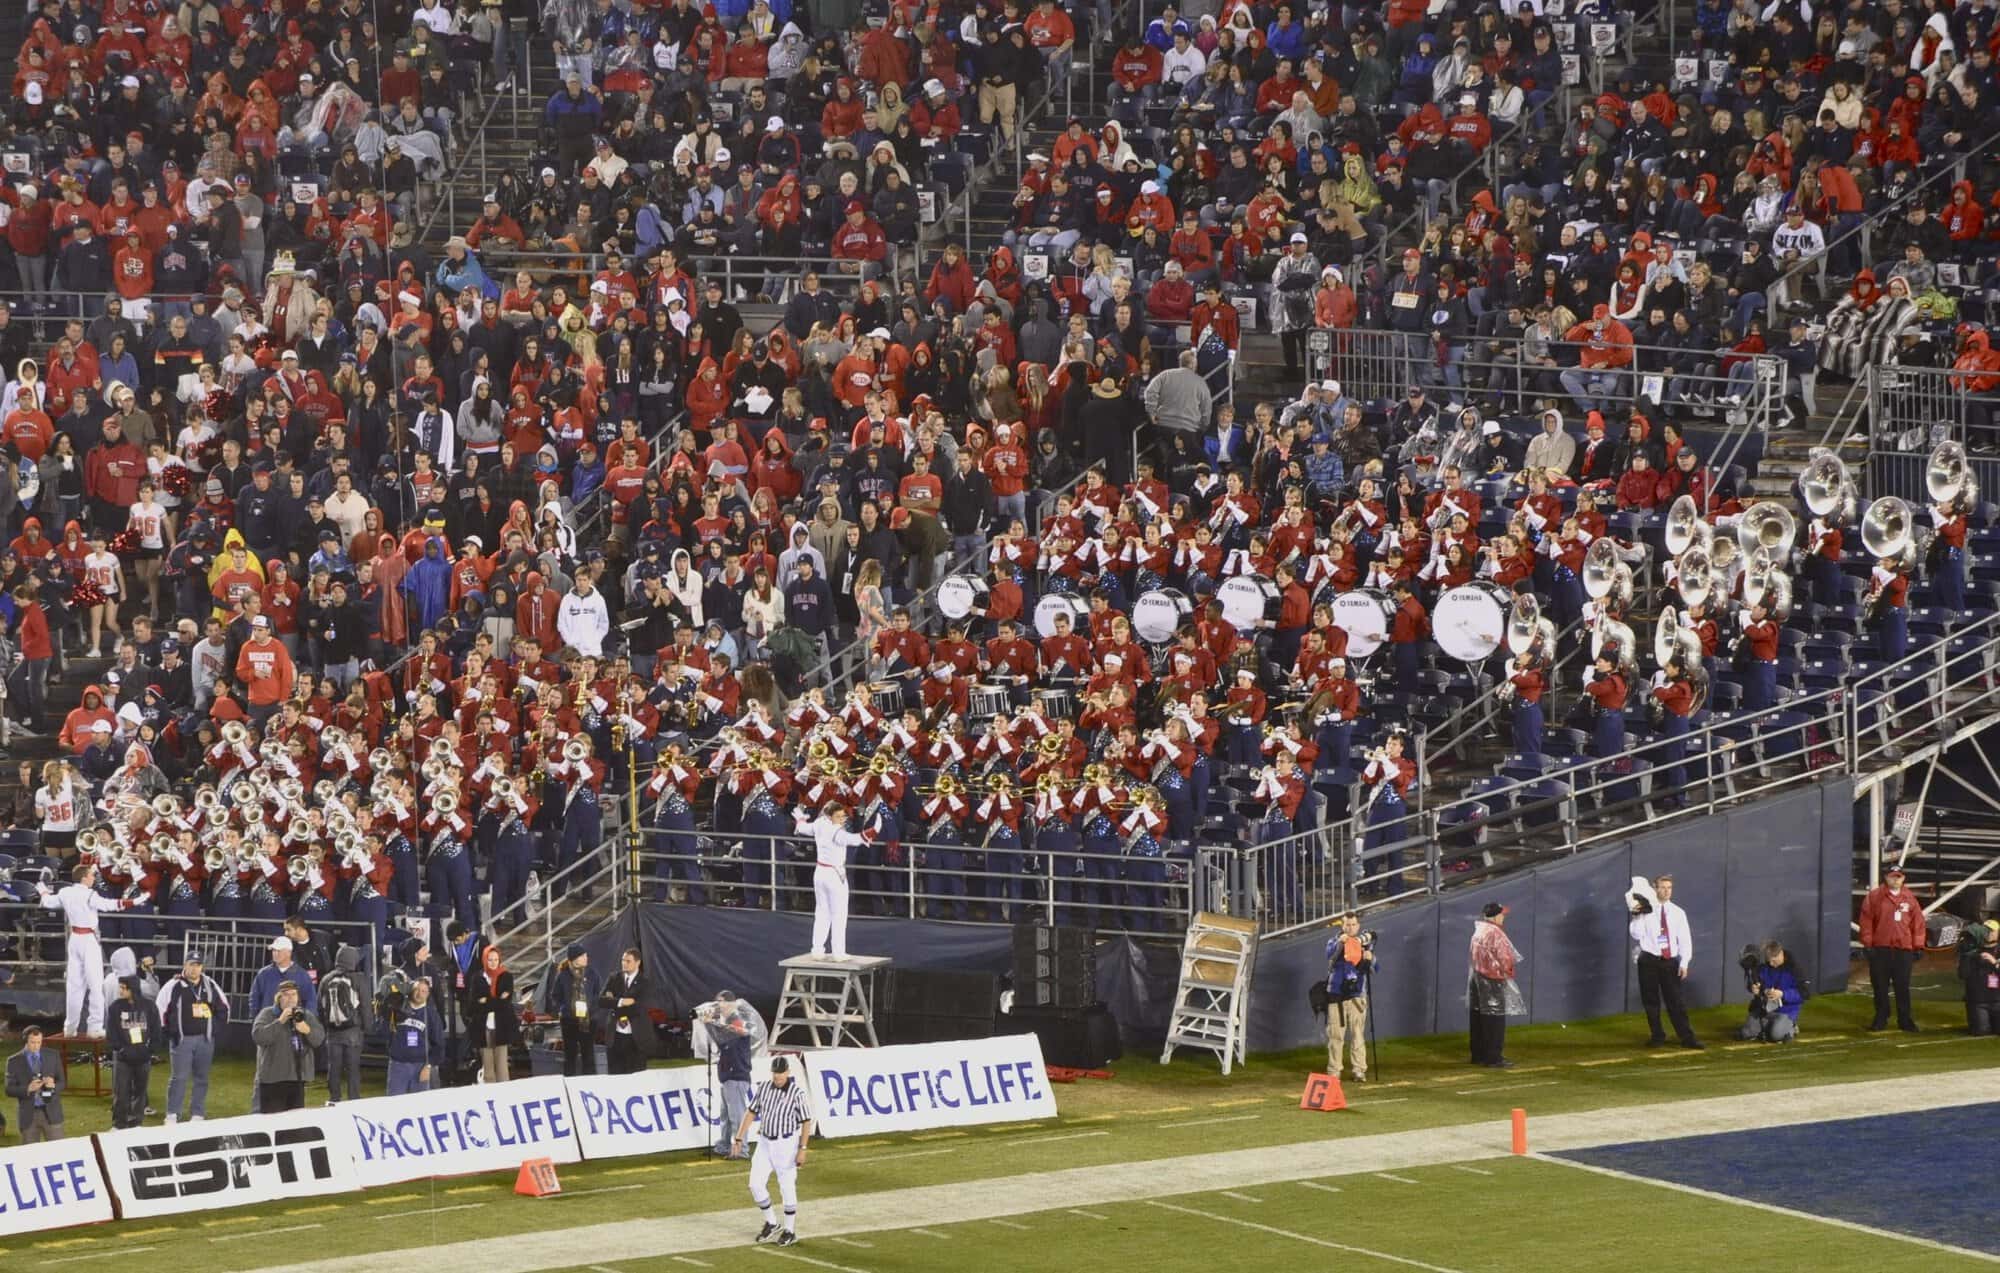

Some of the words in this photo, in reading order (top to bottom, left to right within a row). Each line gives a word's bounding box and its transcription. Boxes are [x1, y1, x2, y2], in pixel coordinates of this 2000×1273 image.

[1234, 584, 1257, 593] YAMAHA
[1459, 594, 1482, 602] YAMAHA
[1148, 599, 1171, 607] YAMAHA
[1347, 599, 1370, 607] YAMAHA
[48, 801, 72, 823] 36
[820, 1069, 961, 1117] PACIFIC
[960, 1060, 1042, 1106] LIFE
[1307, 1080, 1329, 1107] G
[352, 1109, 490, 1160] PACIFIC
[486, 1097, 571, 1146] LIFE
[127, 1126, 332, 1200] ESPN
[5, 1160, 96, 1210] LIFE
[530, 1164, 556, 1193] 10
